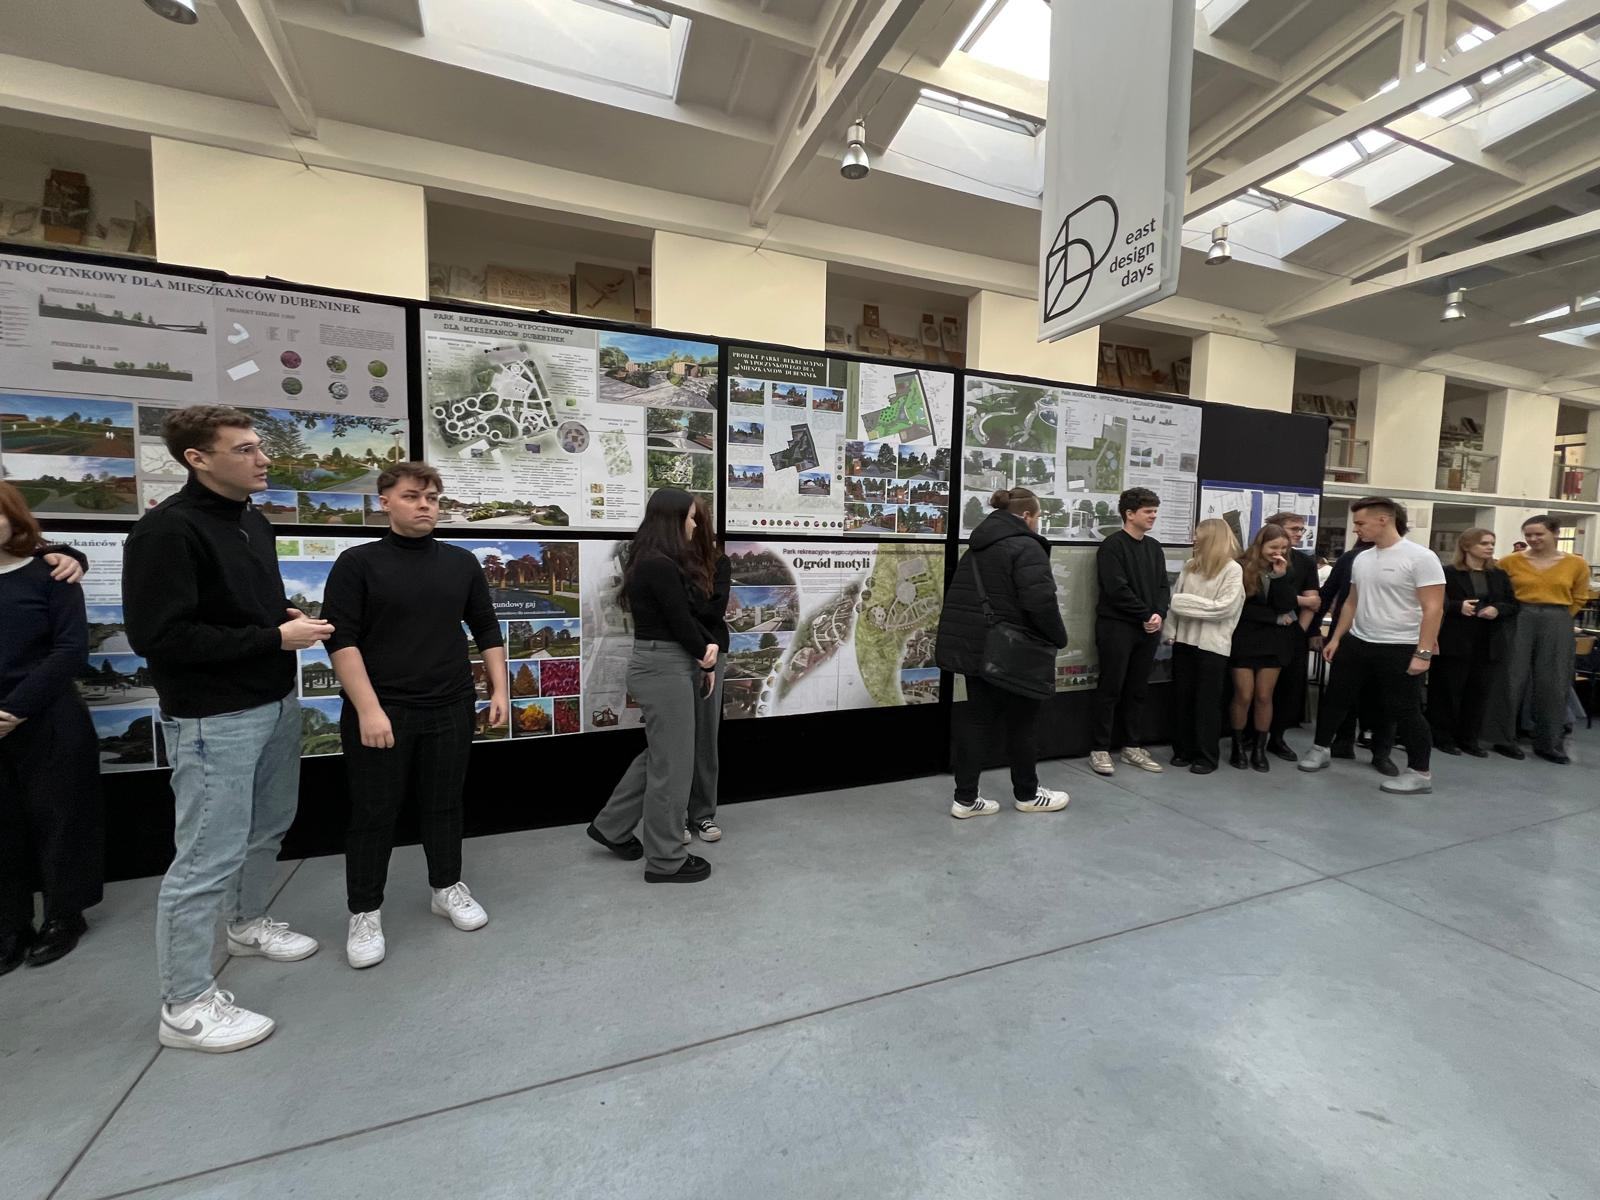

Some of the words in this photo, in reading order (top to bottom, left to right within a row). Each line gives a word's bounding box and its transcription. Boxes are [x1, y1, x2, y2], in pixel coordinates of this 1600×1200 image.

[1125, 218, 1156, 245] east
[1109, 242, 1155, 273] design
[0, 259, 127, 283] YPOCZYNKOWY
[132, 276, 163, 288] DLA
[280, 295, 361, 314] DUBENINEK
[1121, 263, 1154, 287] days
[433, 313, 454, 321] PARK
[793, 557, 831, 571] Ogród
[834, 557, 870, 571] motyli
[492, 600, 524, 609] gundowy
[525, 600, 536, 609] gaj
